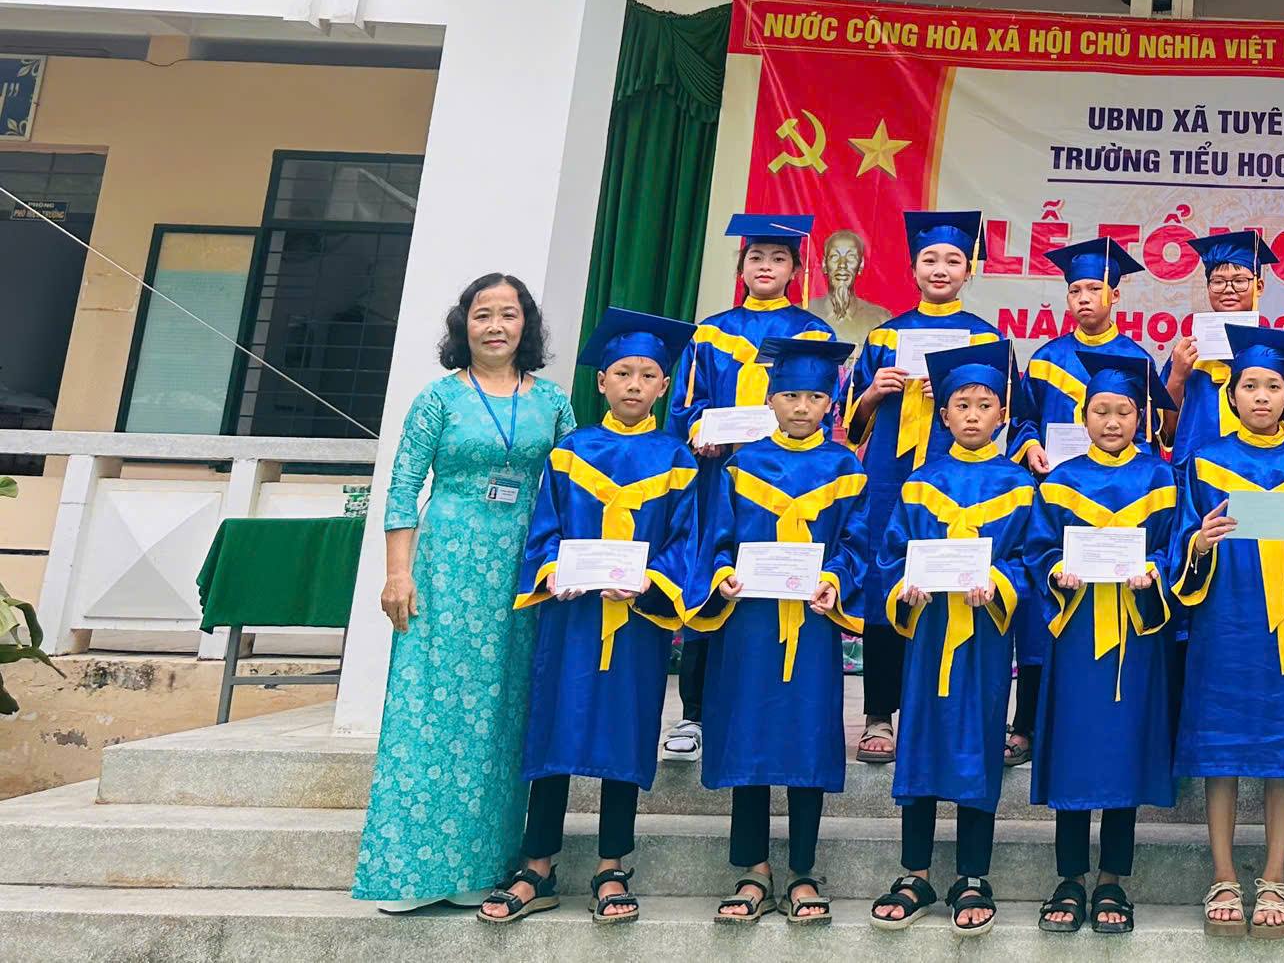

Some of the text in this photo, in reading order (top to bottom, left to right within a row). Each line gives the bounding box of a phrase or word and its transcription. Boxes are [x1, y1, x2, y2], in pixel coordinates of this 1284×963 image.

[764, 12, 838, 41] NƯỚC
[846, 15, 919, 49] CỘNG
[926, 20, 979, 51] HÒA
[985, 27, 1020, 53] XÃ
[1028, 25, 1071, 58] HỘI
[1079, 27, 1131, 56] CHỦ
[1138, 33, 1216, 59] NGHĨA
[1224, 35, 1276, 64] VIỆT
[1087, 106, 1164, 132] UBND
[1172, 104, 1210, 133] XÃ
[1050, 142, 1161, 173] TRƯỜNG
[1170, 141, 1228, 177] TIỂU
[983, 199, 1070, 277] LỄ
